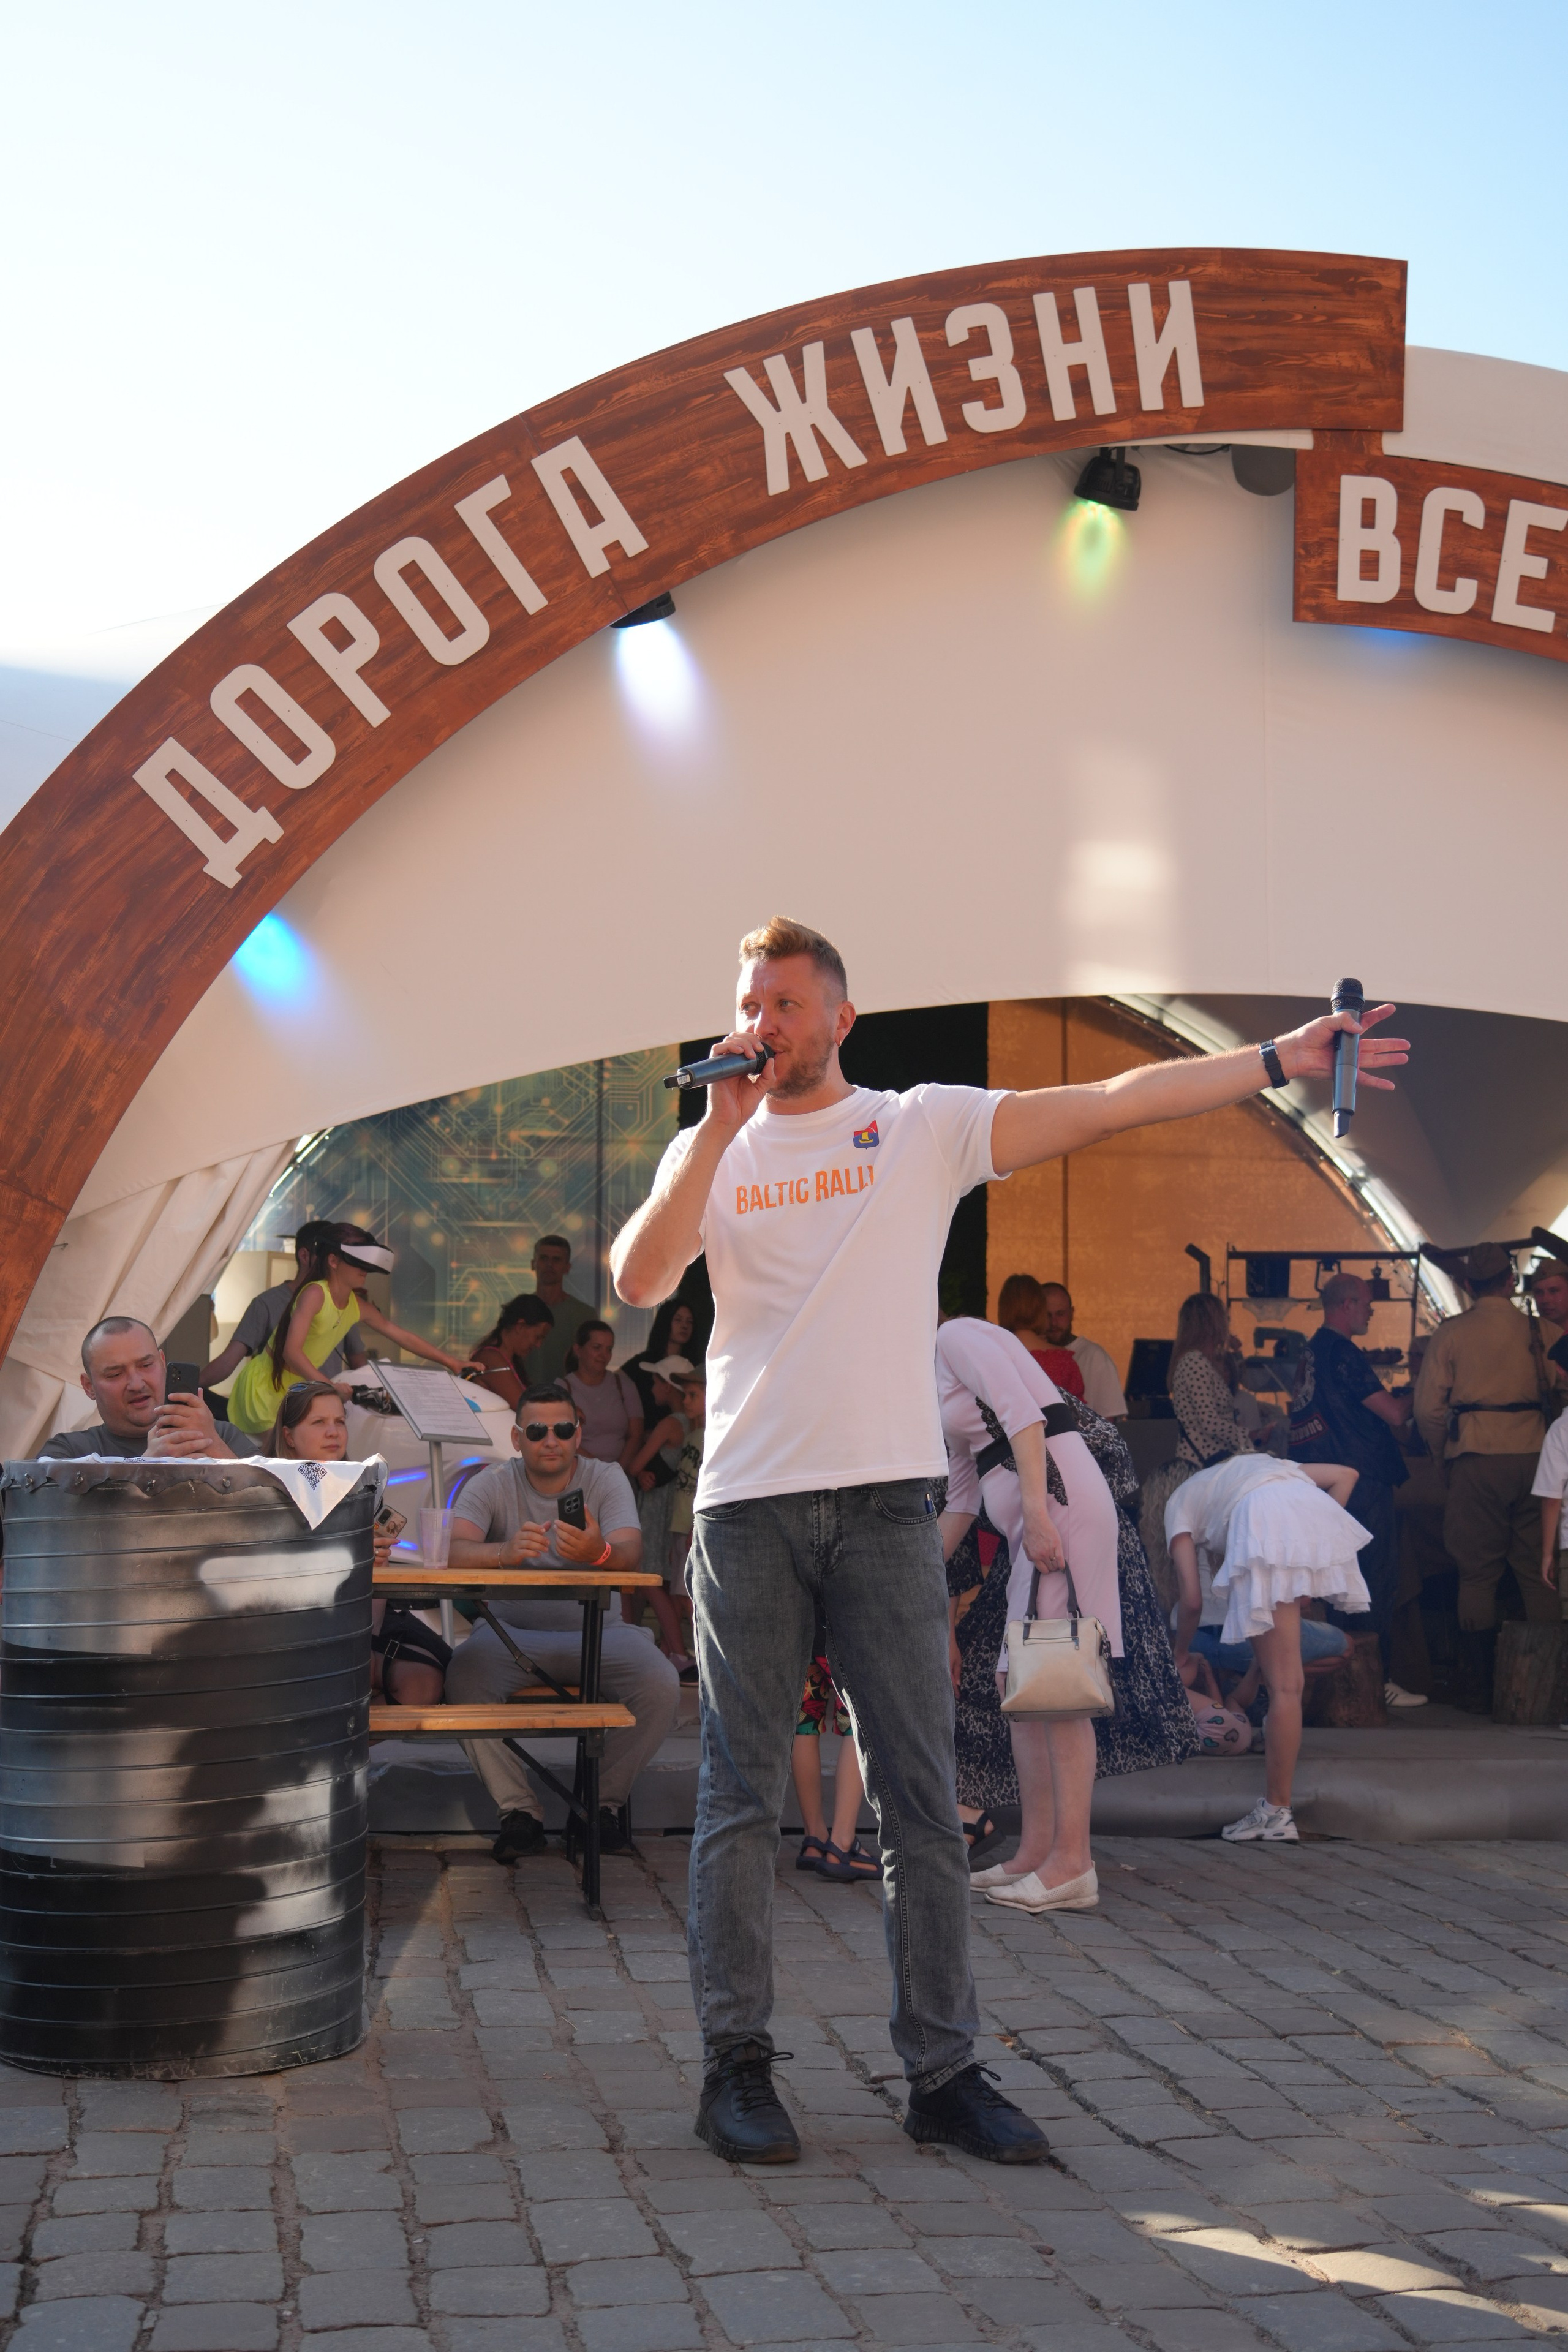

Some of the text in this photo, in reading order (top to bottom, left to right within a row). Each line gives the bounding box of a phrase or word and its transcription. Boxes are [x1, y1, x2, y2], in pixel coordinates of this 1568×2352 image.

[132, 280, 1204, 889] ДОРОГА ЖИЗНИ
[1337, 474, 1568, 638] ВСЕ
[736, 1177, 809, 1215] BALTIC
